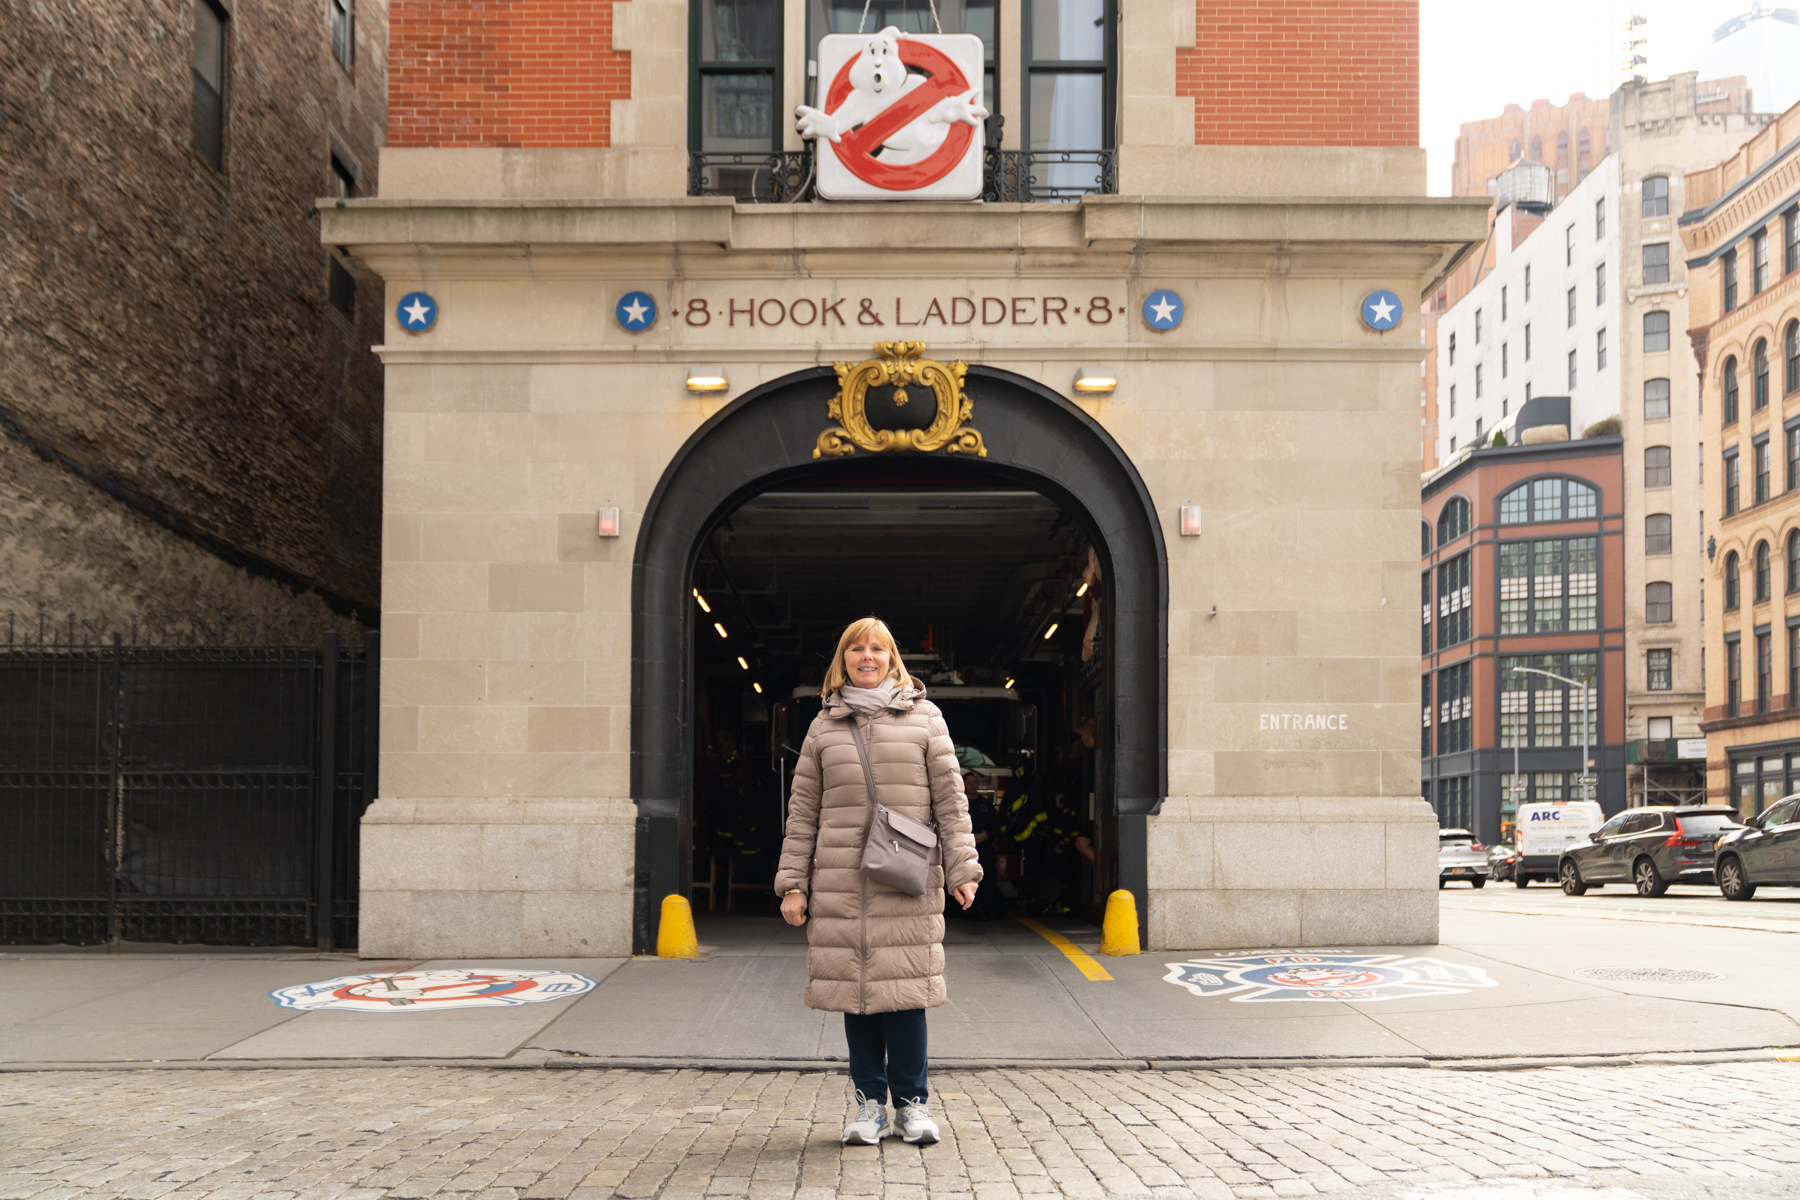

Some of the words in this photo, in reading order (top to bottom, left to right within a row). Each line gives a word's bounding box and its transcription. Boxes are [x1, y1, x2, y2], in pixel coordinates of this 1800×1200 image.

[685, 298, 712, 326] 8
[728, 298, 849, 327] HOOK
[857, 298, 885, 326] &
[895, 297, 1070, 326] LADDER
[1086, 296, 1114, 325] 8
[1260, 713, 1348, 730] ENTRANCE
[1530, 811, 1560, 822] ARC
